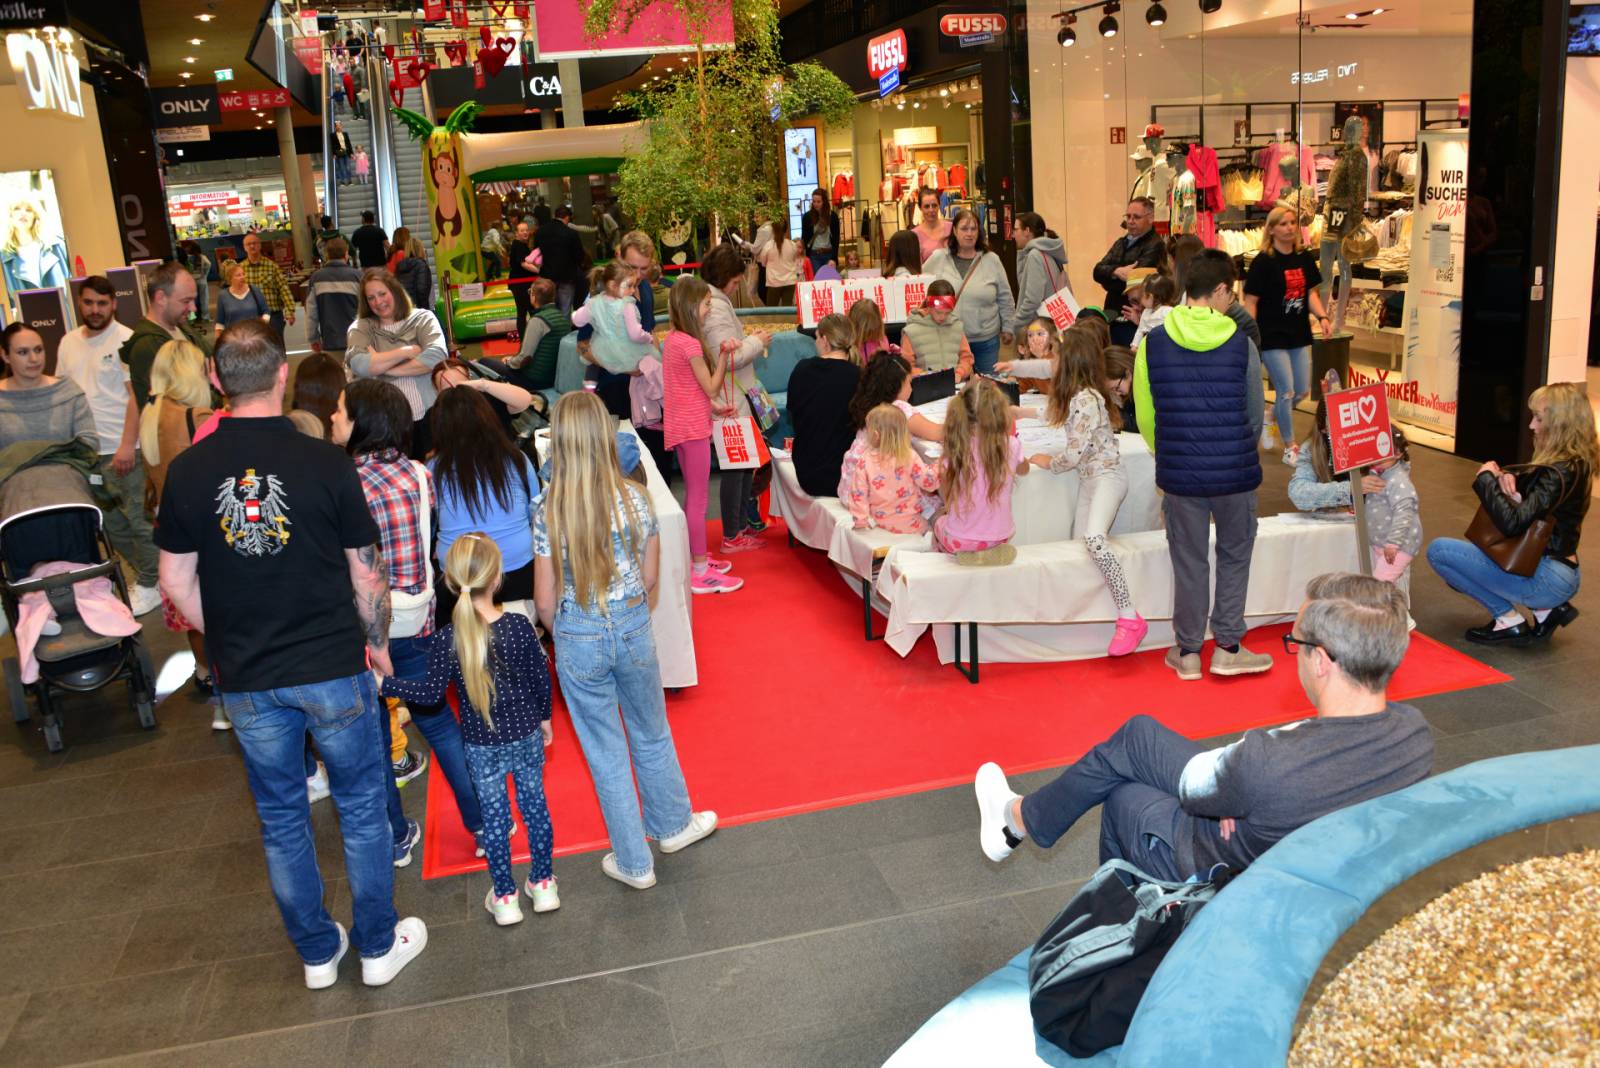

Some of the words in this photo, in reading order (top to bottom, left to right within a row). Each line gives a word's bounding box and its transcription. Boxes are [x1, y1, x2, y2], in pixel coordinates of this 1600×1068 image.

[947, 17, 1002, 32] FUSSL
[871, 36, 905, 72] FUSSL
[20, 34, 85, 118] ONLY
[529, 75, 562, 96] C&A
[160, 98, 210, 114] ONLY
[221, 95, 243, 107] WC
[1441, 170, 1464, 184] WIR
[189, 191, 230, 201] INFORMATION
[904, 282, 925, 294] ALLE
[31, 319, 57, 327] ONLY
[1339, 400, 1360, 428] Eli
[721, 424, 744, 438] ALLE
[723, 437, 745, 447] LIEBEN
[725, 446, 750, 464] Eli
